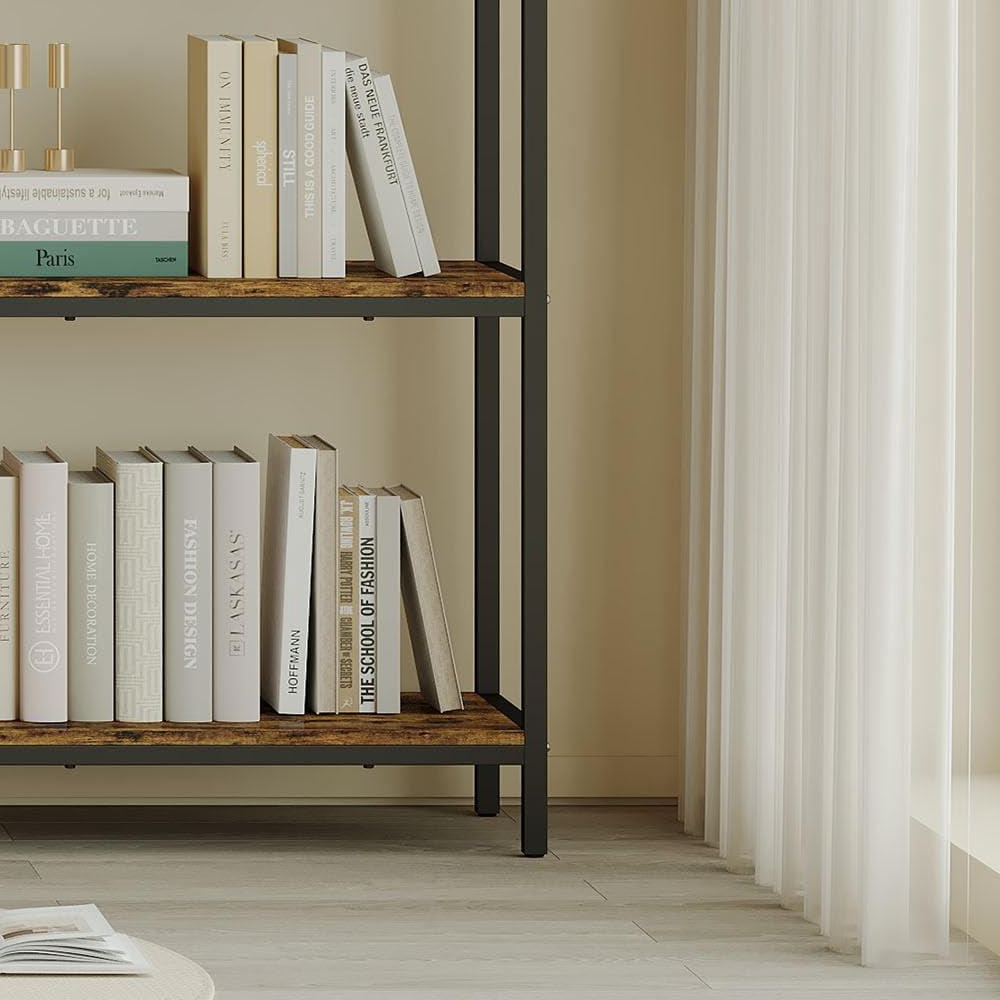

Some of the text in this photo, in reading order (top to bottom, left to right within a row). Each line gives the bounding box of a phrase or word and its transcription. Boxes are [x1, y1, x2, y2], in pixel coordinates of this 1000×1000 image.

[219, 71, 231, 171] ON IMMUNITY
[345, 67, 370, 139] die neue stadt
[358, 62, 399, 186] DAS NEUE FRANKFURT
[253, 140, 272, 187] spherical
[282, 150, 296, 188] STILL
[304, 95, 315, 218] THIS IS A GOOD GUIDE
[32, 188, 87, 200] sustainable
[89, 188, 95, 197] a
[98, 188, 111, 200] for
[0, 218, 138, 236] BAGUETTE
[35, 248, 75, 267] Paris
[340, 516, 353, 548] ROWLING
[35, 512, 51, 633] ESSENTIAL HOME
[230, 533, 244, 636] LASKASAS
[340, 551, 353, 575] HARRY
[0, 550, 10, 642] FURNITURE
[86, 542, 97, 665] HOME DECORATION
[184, 519, 198, 670] FASHION DESIGN
[340, 576, 353, 604] POTTER
[340, 617, 353, 651] CHAMBER
[360, 537, 375, 704] THE SCHOOL OF FASHION
[288, 629, 300, 694] HOFFMANN
[340, 658, 353, 689] SECRETS
